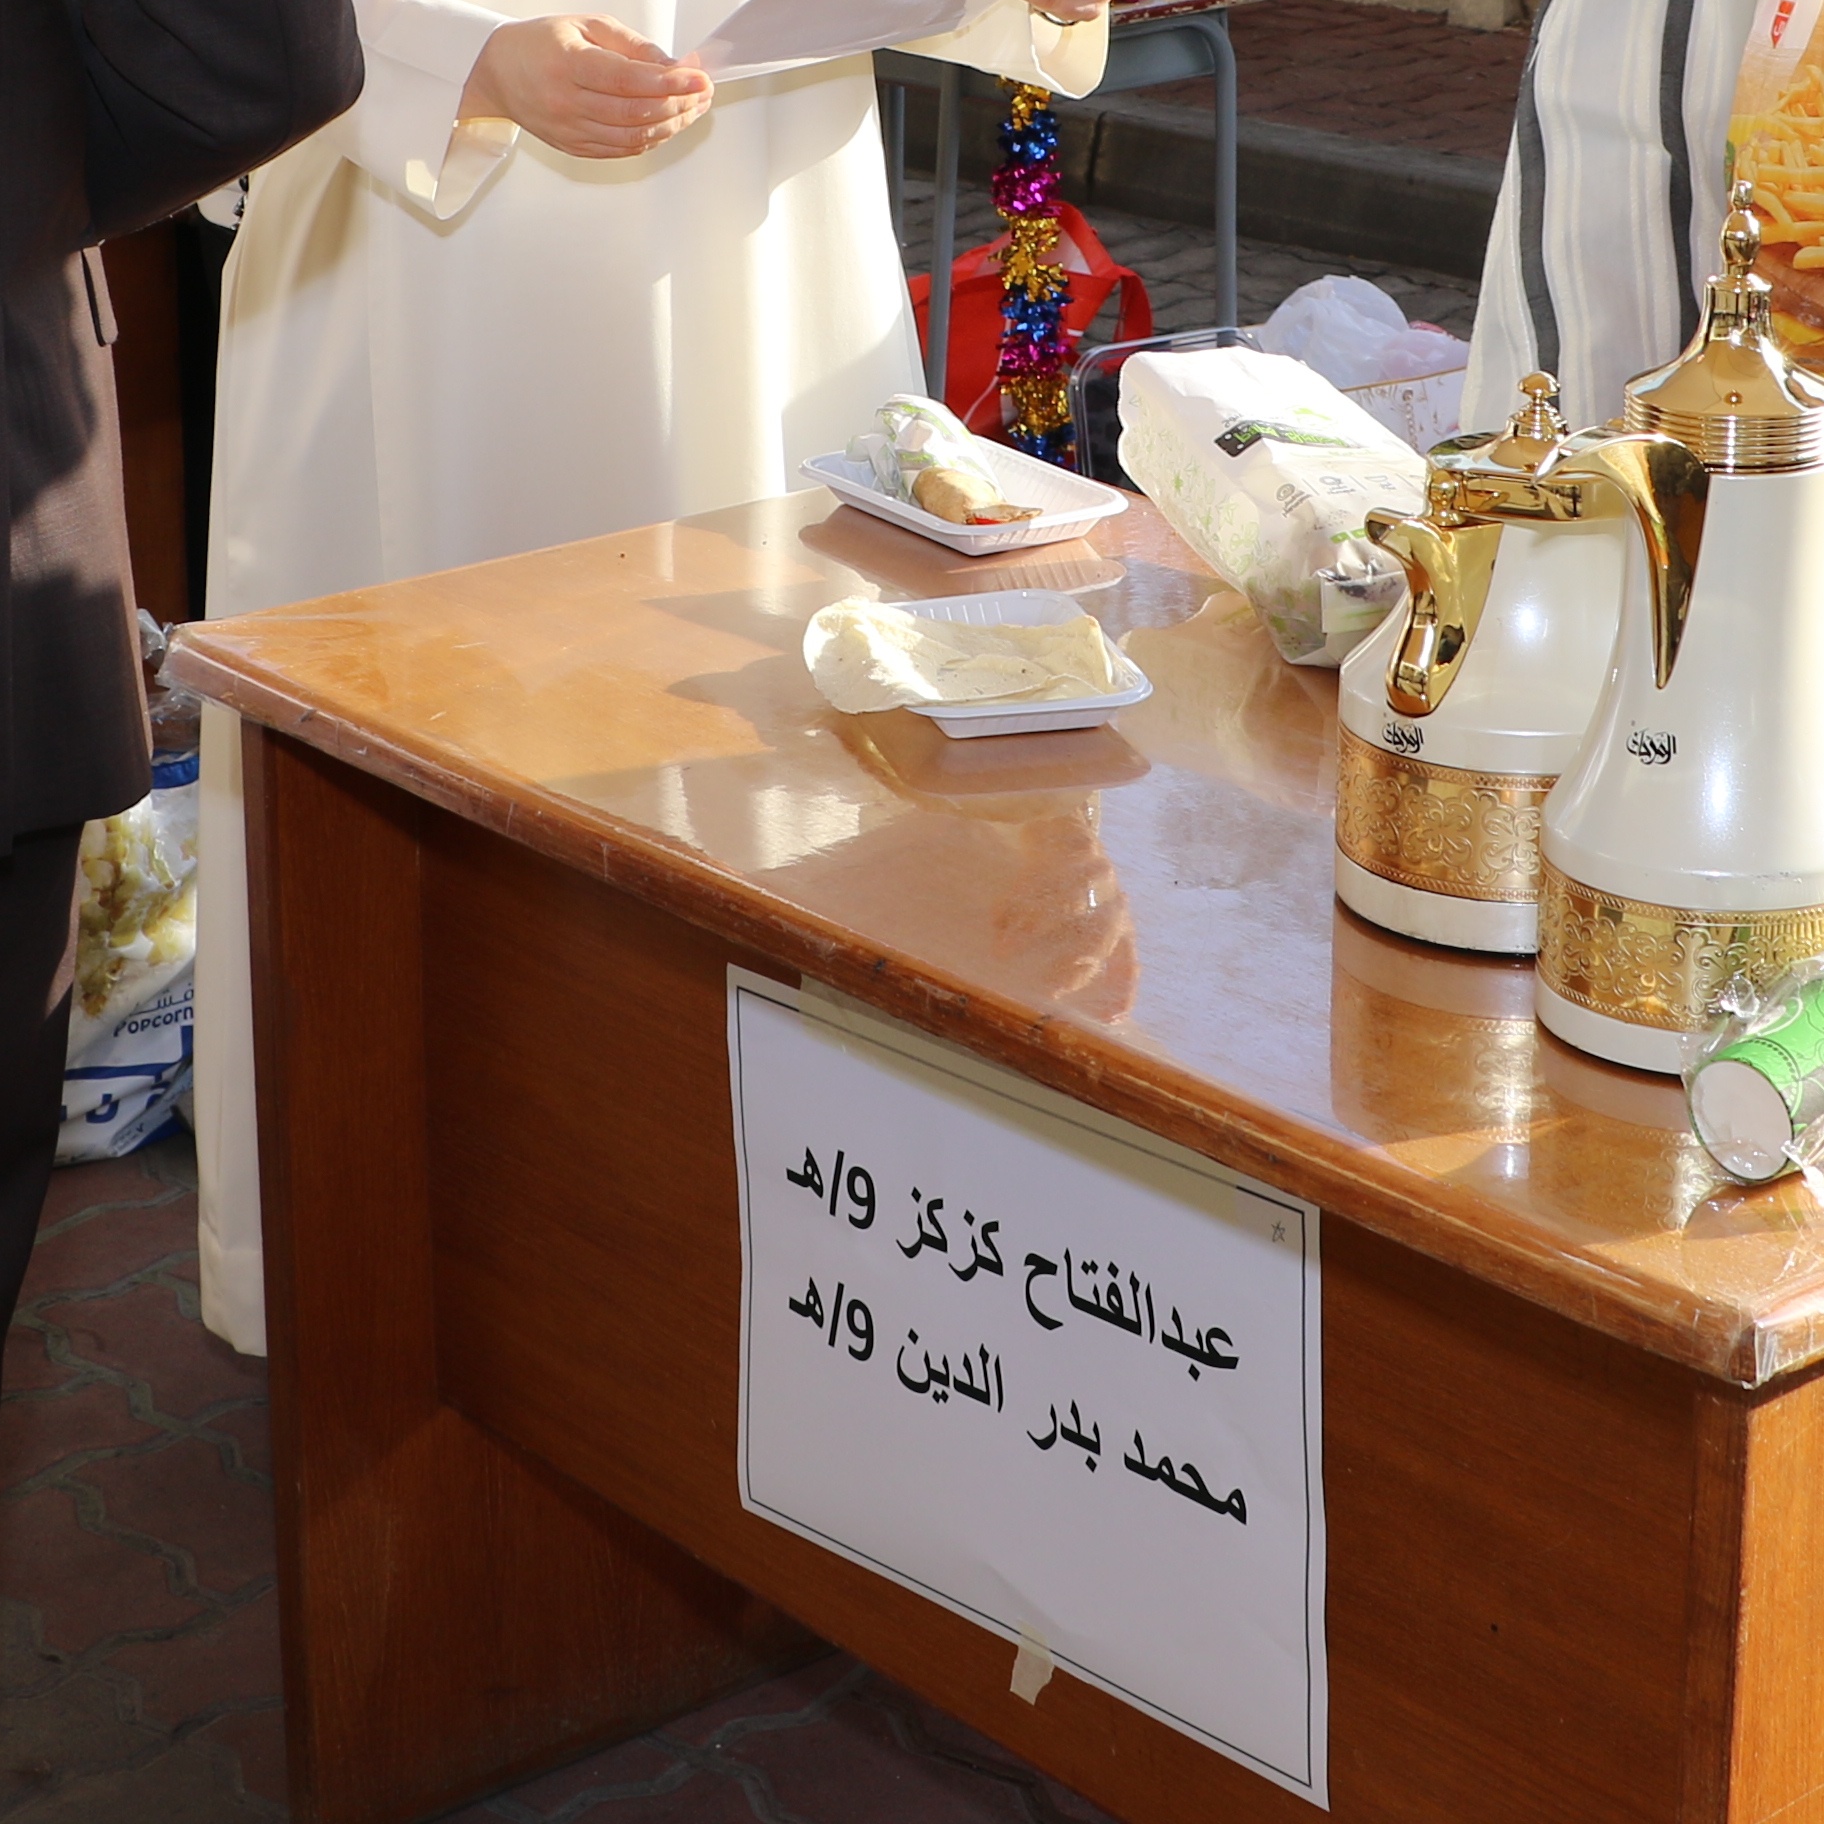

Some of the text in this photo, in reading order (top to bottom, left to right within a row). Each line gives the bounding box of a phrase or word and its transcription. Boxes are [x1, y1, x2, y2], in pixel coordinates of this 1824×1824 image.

[896, 1186, 1004, 1282] كزكز
[1024, 1248, 1239, 1382] عبدالفتاح
[896, 1328, 1004, 1413] الدين
[1026, 1400, 1101, 1473] بدر
[1123, 1429, 1247, 1525] محمد
